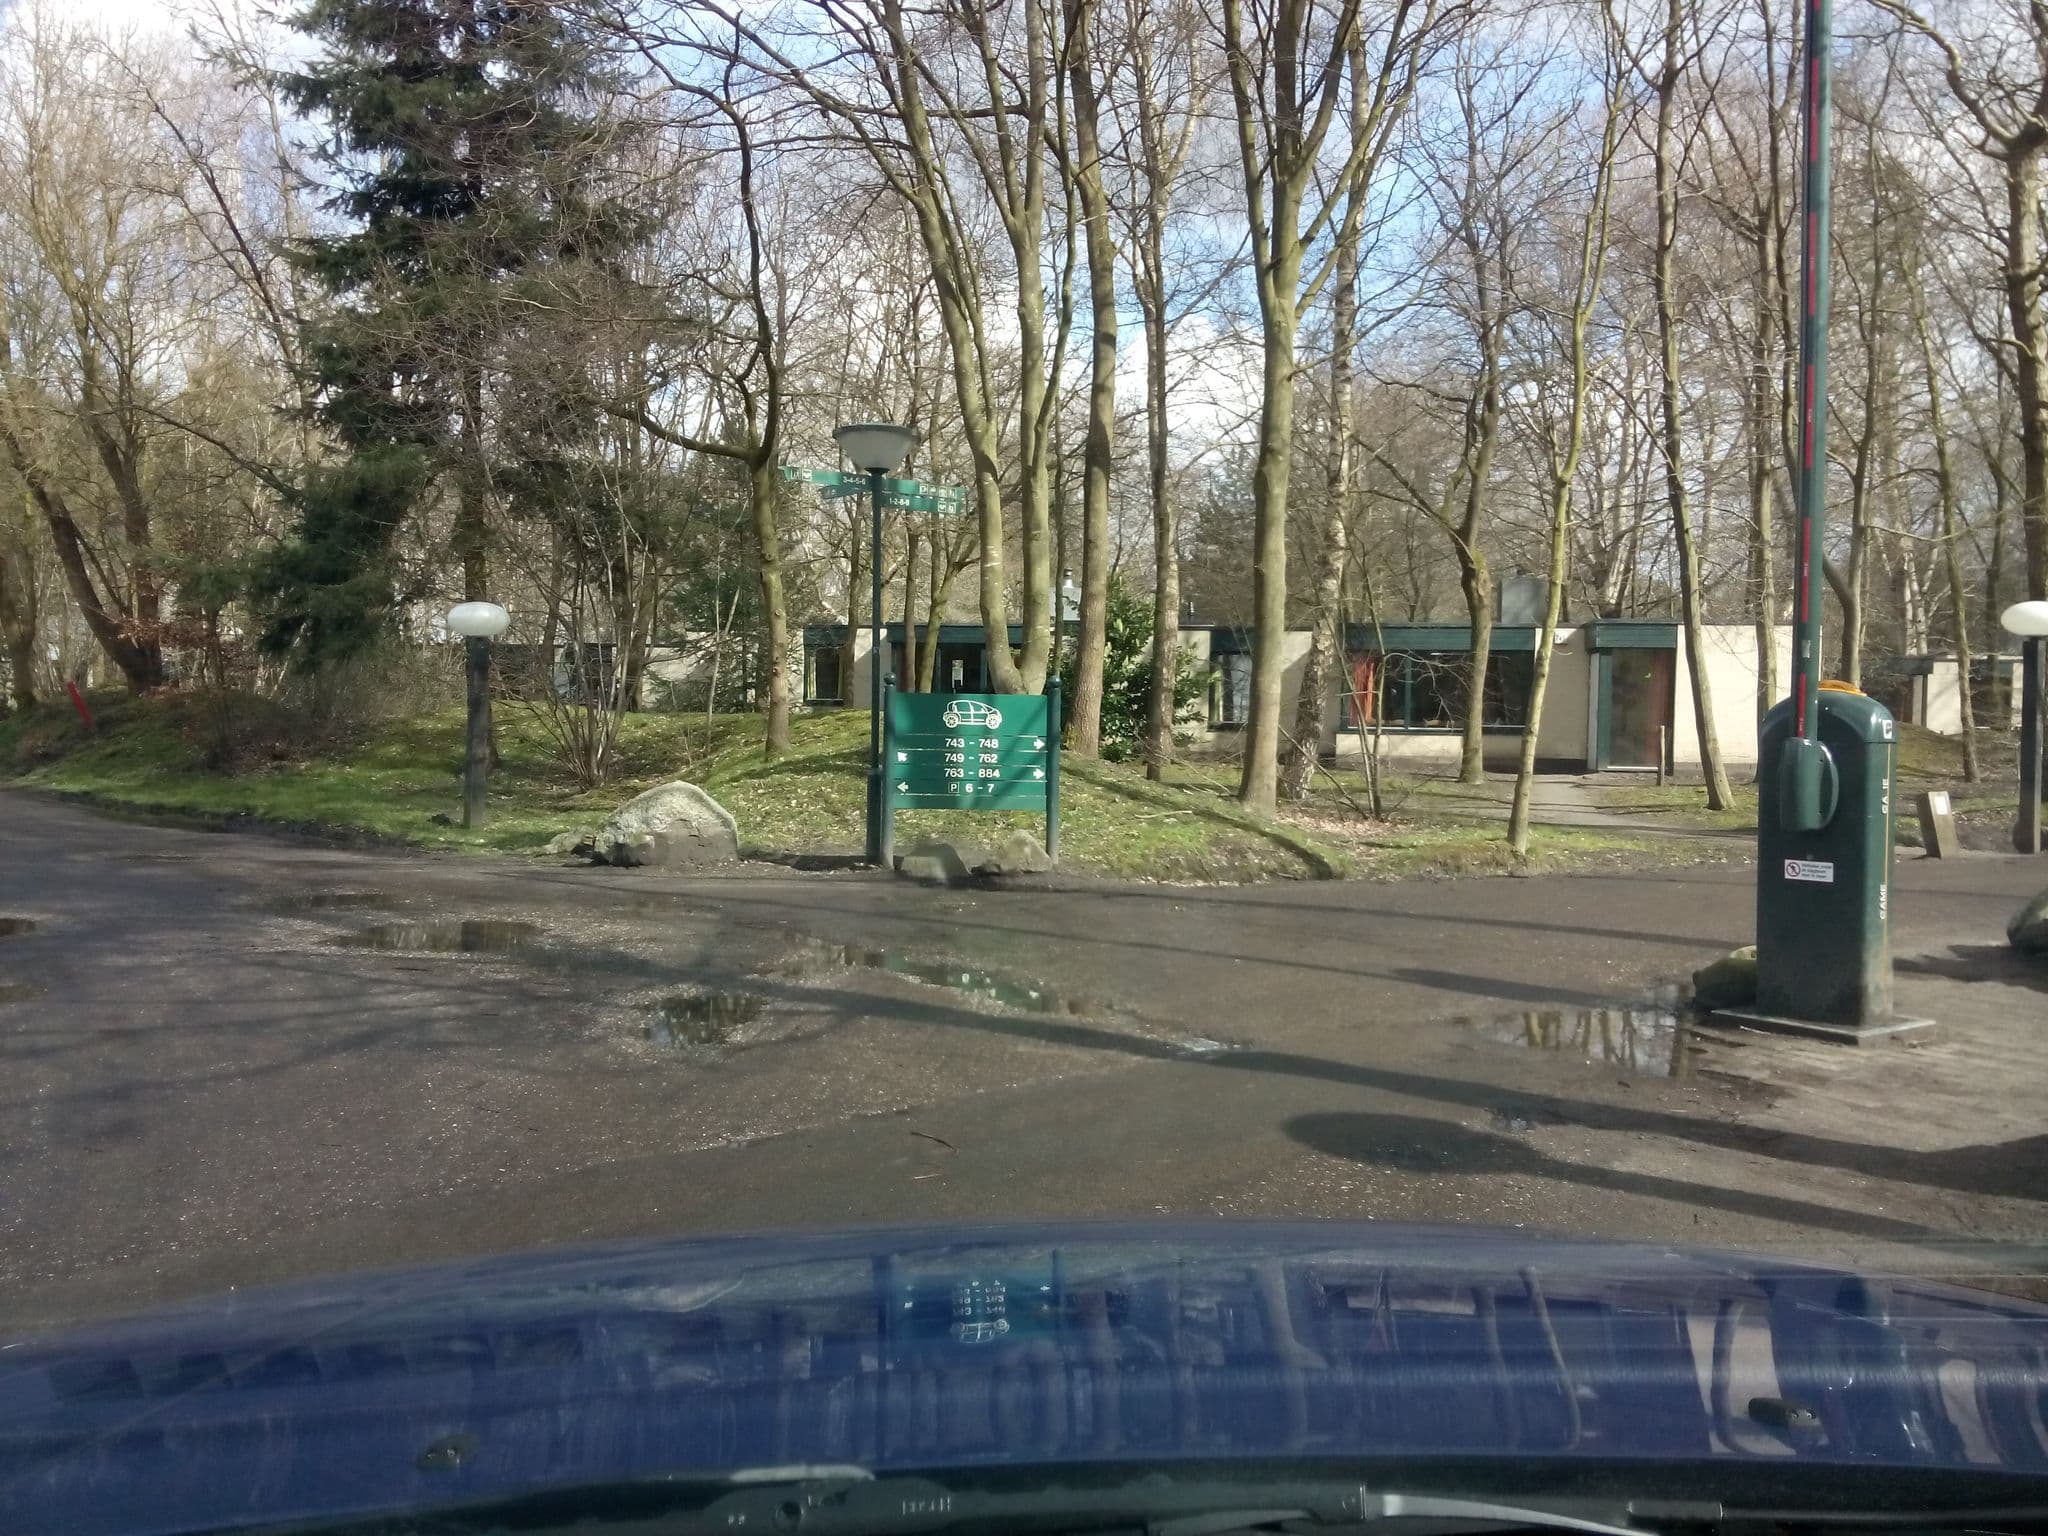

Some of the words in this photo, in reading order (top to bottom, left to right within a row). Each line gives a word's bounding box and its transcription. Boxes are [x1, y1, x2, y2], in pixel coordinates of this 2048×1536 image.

[945, 738, 965, 748] 743
[979, 738, 999, 749] 748
[945, 753, 965, 763] 749
[978, 753, 998, 763] 762
[944, 768, 965, 778] 763
[978, 768, 1000, 778] 884
[965, 783, 974, 793] 6
[987, 783, 995, 793] 7
